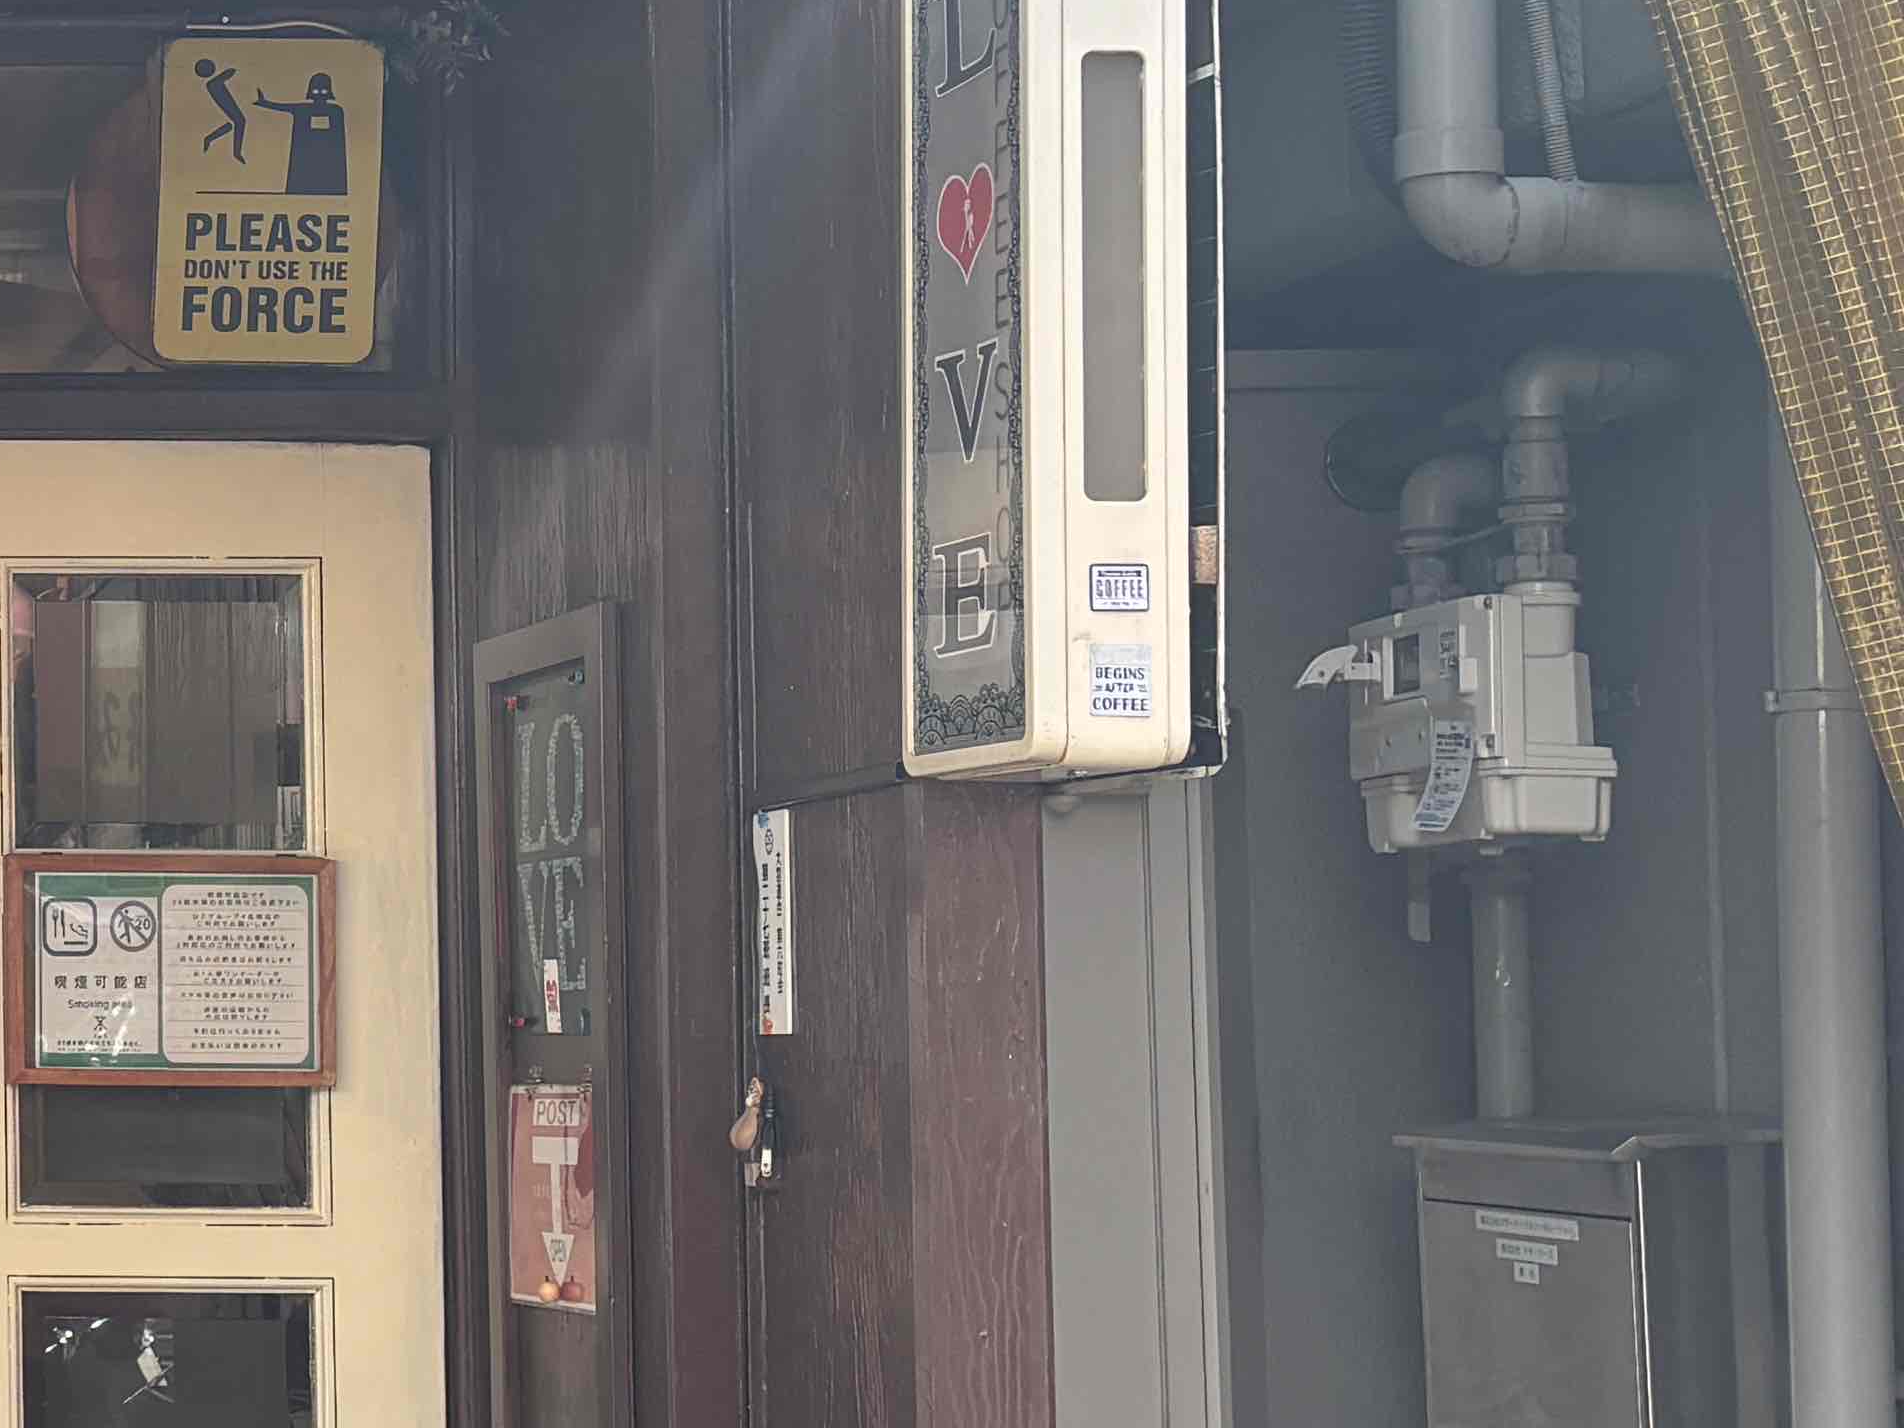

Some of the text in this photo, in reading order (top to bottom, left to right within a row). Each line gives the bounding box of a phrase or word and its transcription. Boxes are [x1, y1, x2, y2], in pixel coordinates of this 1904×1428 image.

[185, 213, 350, 253] PLEASE
[184, 259, 348, 281] DON'T USE THE
[181, 286, 348, 334] FORCE
[1095, 667, 1145, 680] BEGINS
[1093, 697, 1149, 711] COFFEE
[54, 975, 147, 989] 喫煙可能店
[536, 1101, 576, 1124] POST
